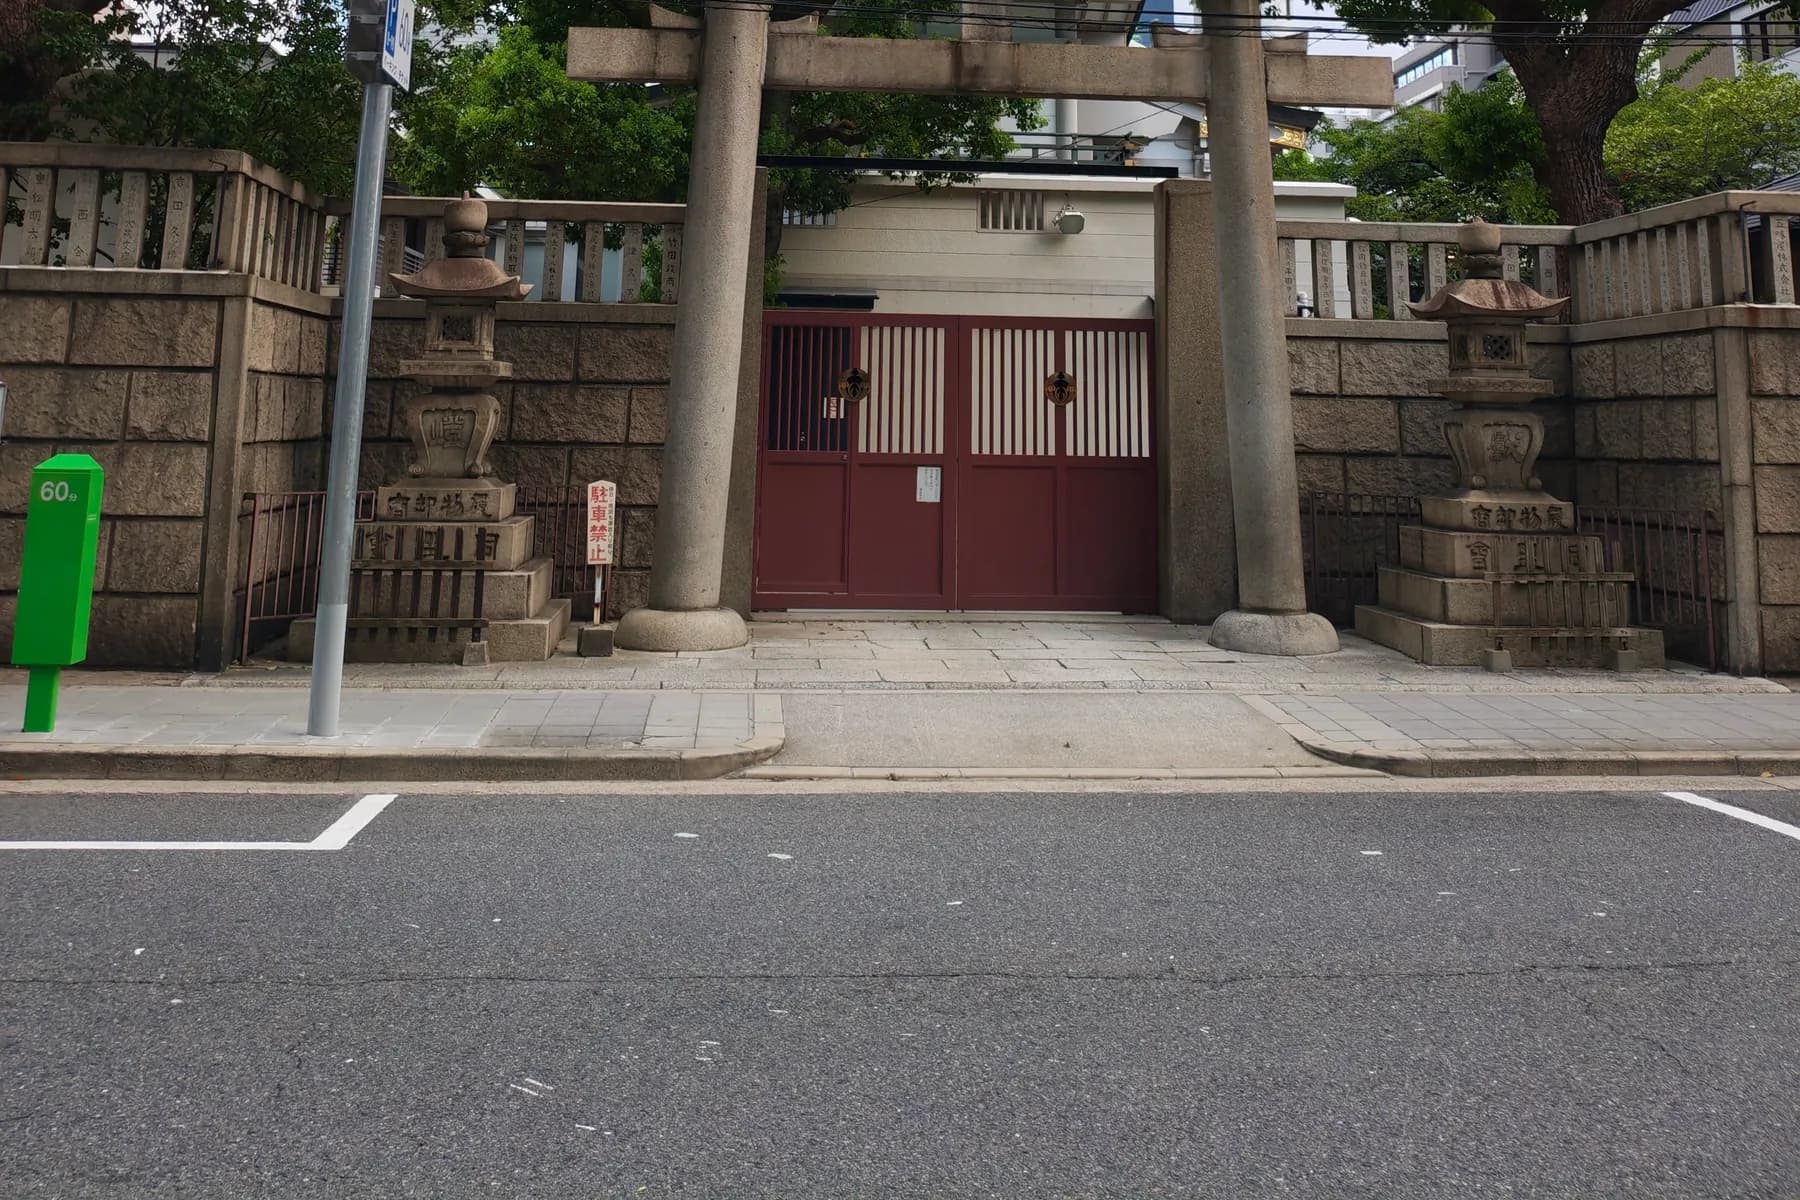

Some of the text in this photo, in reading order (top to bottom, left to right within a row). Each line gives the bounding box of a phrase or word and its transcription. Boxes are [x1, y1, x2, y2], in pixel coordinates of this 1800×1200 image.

[40, 481, 77, 502] 60分
[590, 486, 608, 561] 駐車禁止
